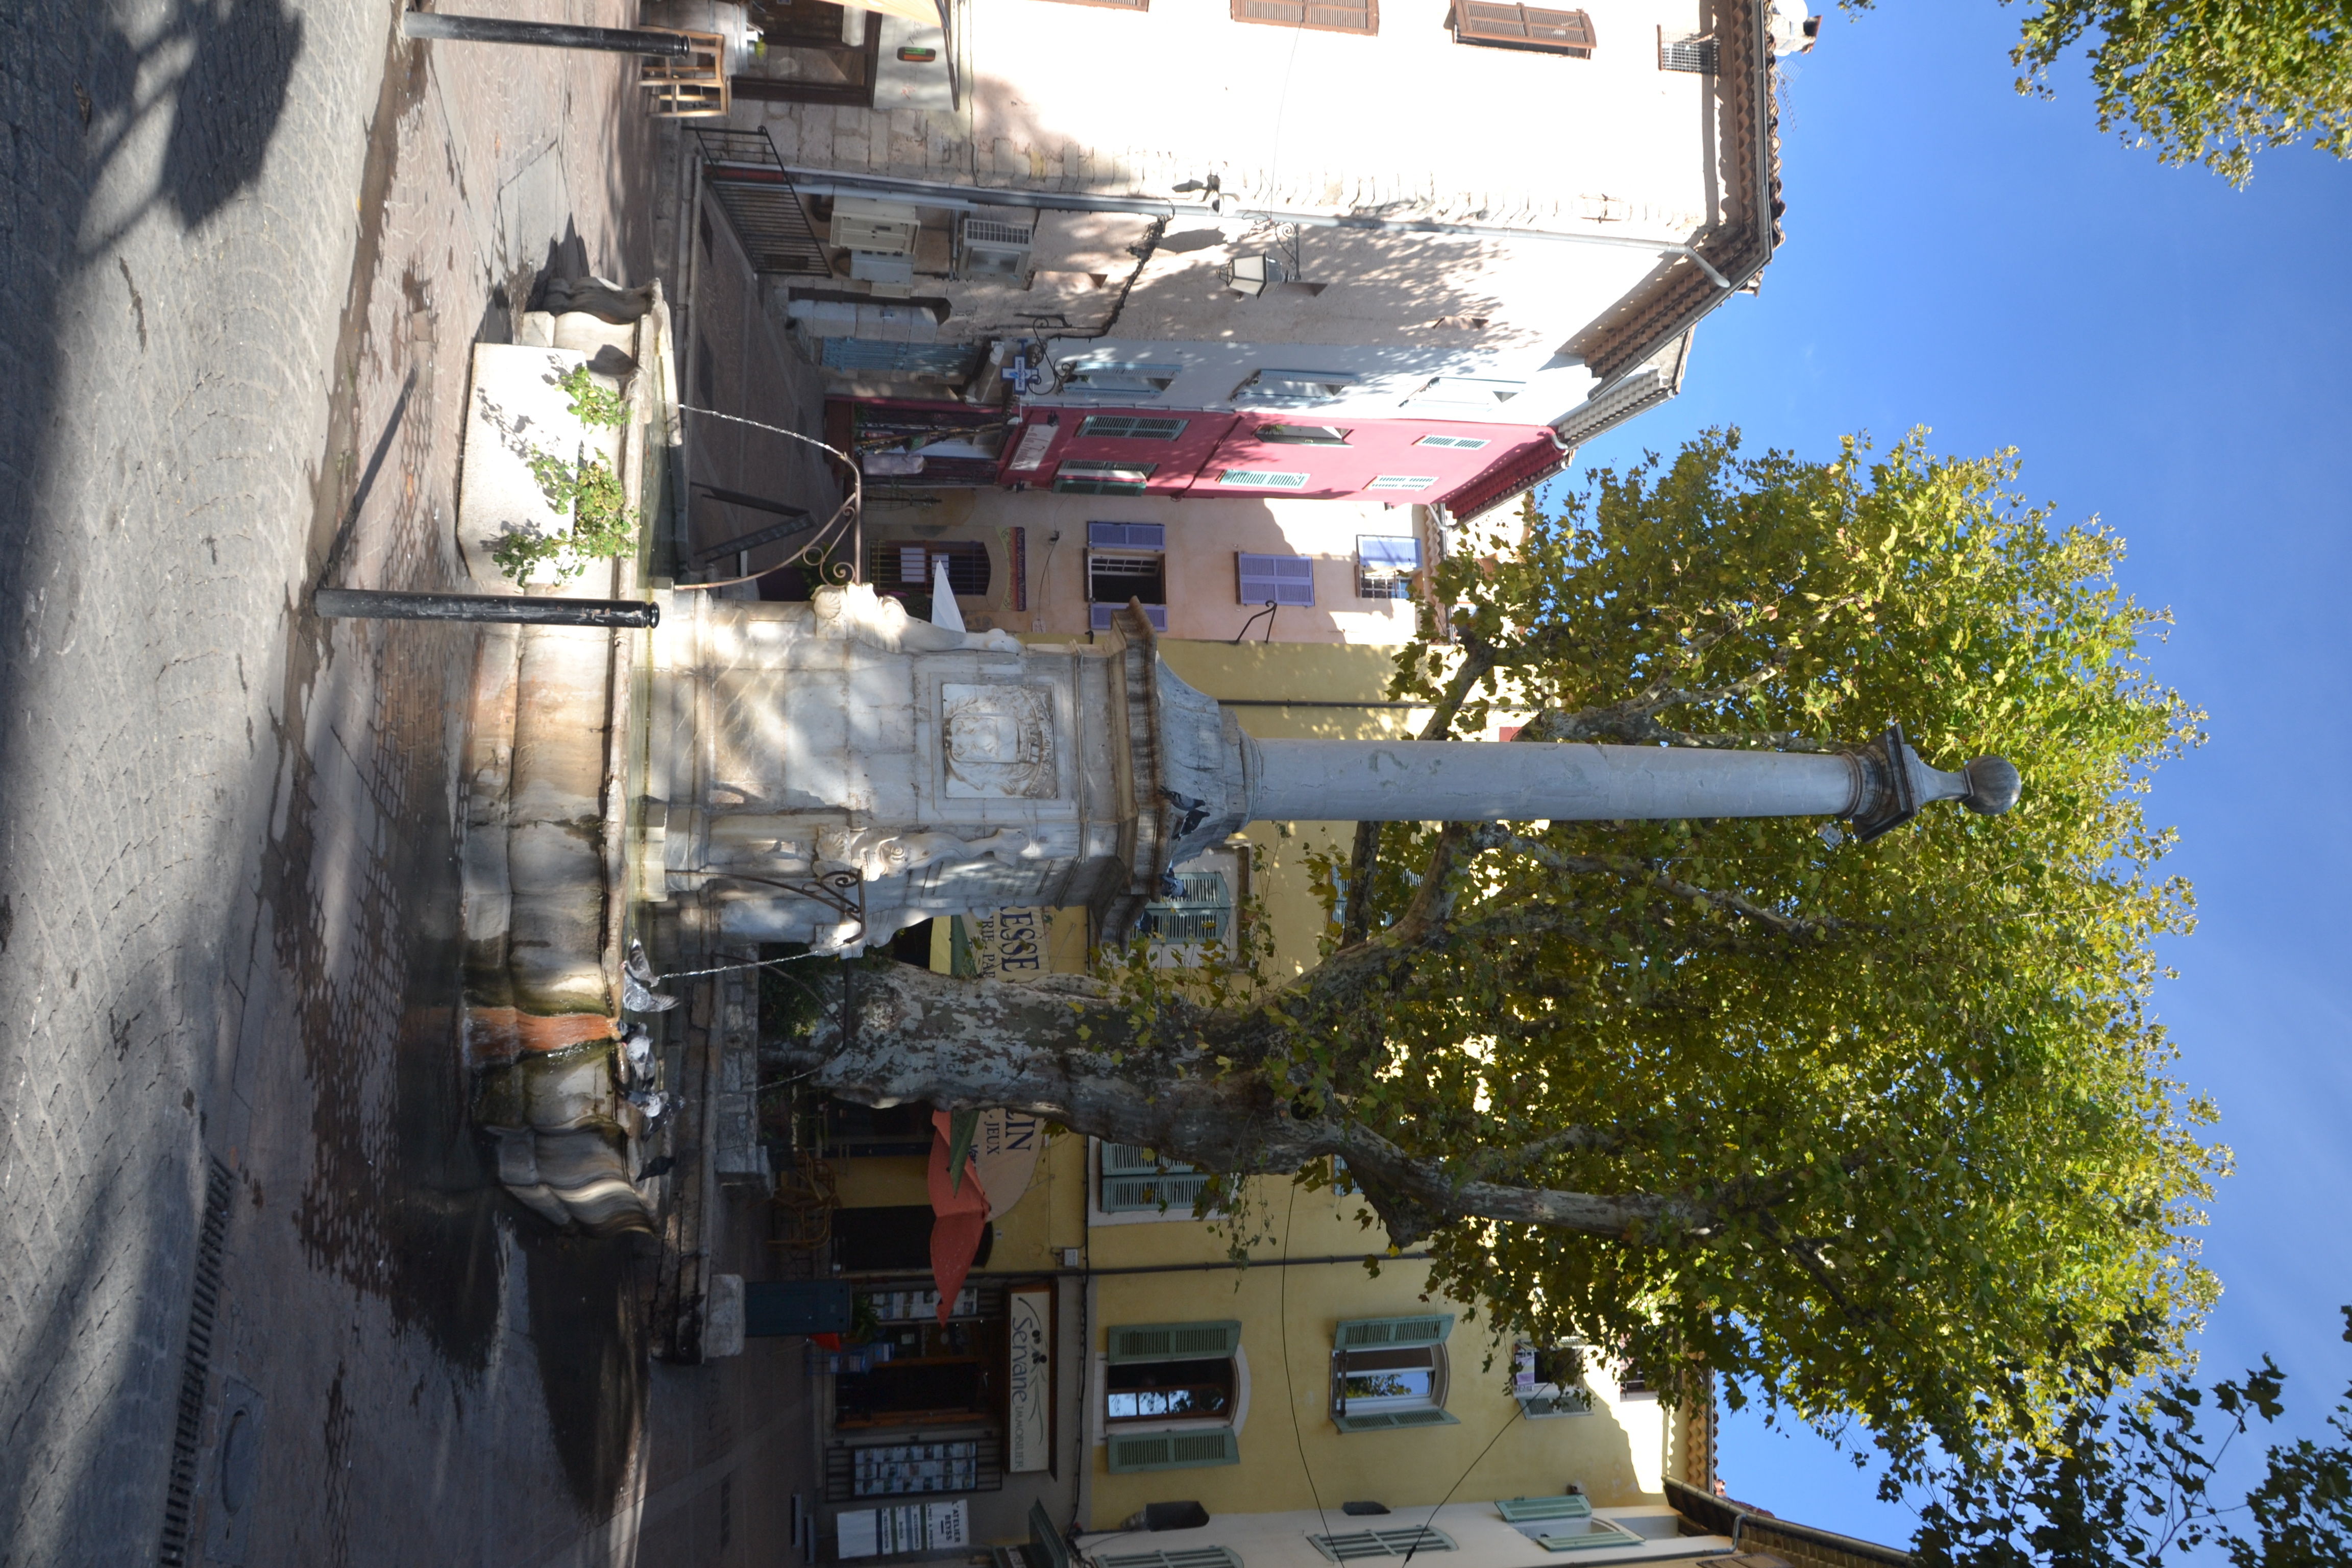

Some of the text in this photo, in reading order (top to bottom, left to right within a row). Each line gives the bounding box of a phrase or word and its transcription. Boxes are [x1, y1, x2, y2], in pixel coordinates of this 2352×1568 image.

[982, 915, 994, 941] RIE
[984, 1121, 999, 1156] JEUX
[1011, 1317, 1033, 1470] Servane IMMOBILIER
